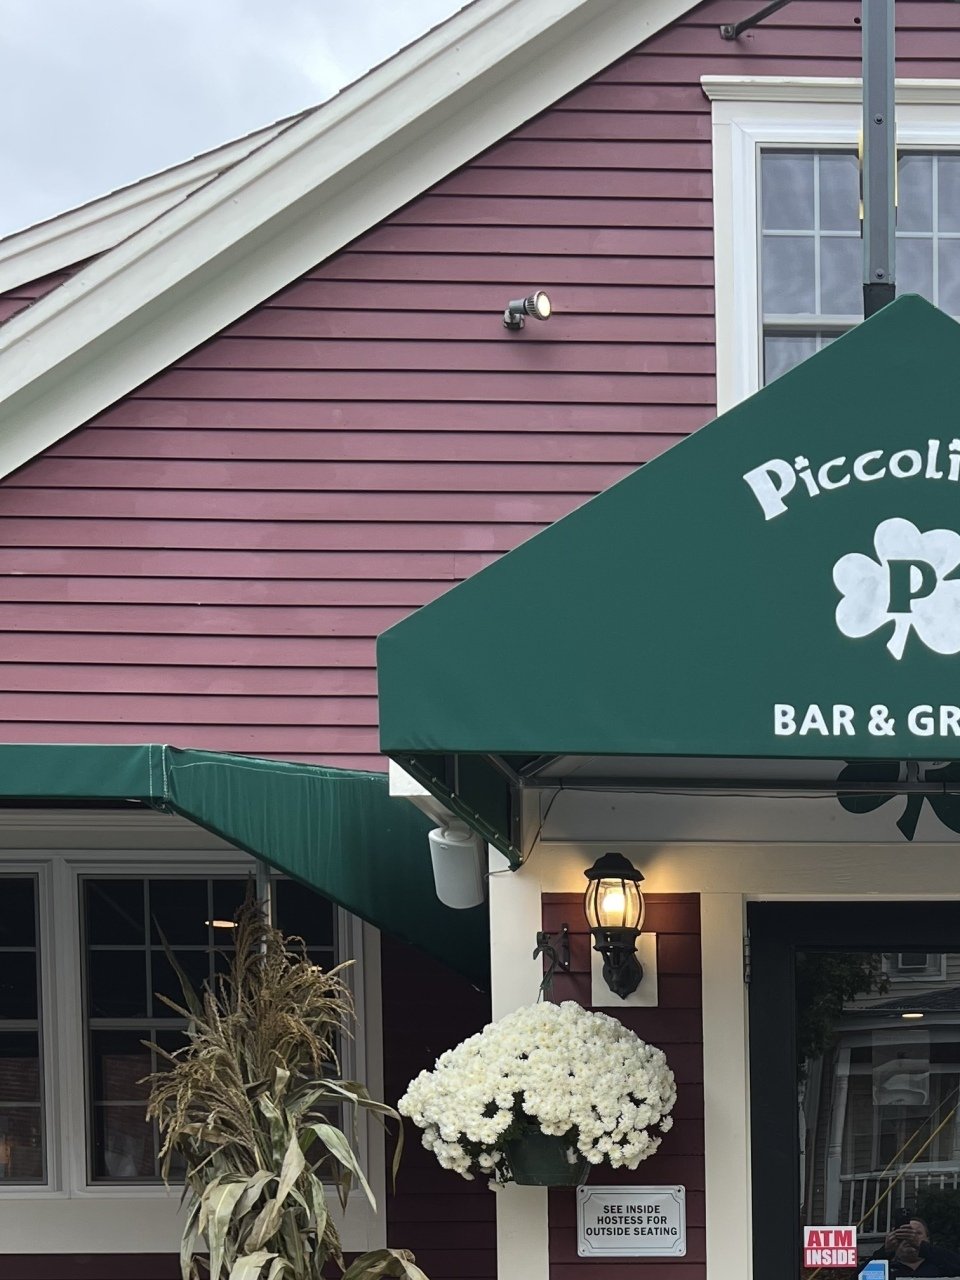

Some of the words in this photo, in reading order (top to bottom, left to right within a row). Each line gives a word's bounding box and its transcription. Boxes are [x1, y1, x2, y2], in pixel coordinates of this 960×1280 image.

[886, 559, 938, 614] P
[774, 704, 856, 736] BAR
[868, 704, 896, 736] &
[603, 1205, 623, 1213] SEE
[626, 1205, 661, 1213] INSIDE
[597, 1216, 643, 1224] HOSTESS
[647, 1216, 667, 1224] FOR
[586, 1227, 630, 1236] OUTSIDE
[633, 1227, 678, 1236] SEATING
[807, 1230, 852, 1247] ATM
[806, 1249, 856, 1265] INSIDE
